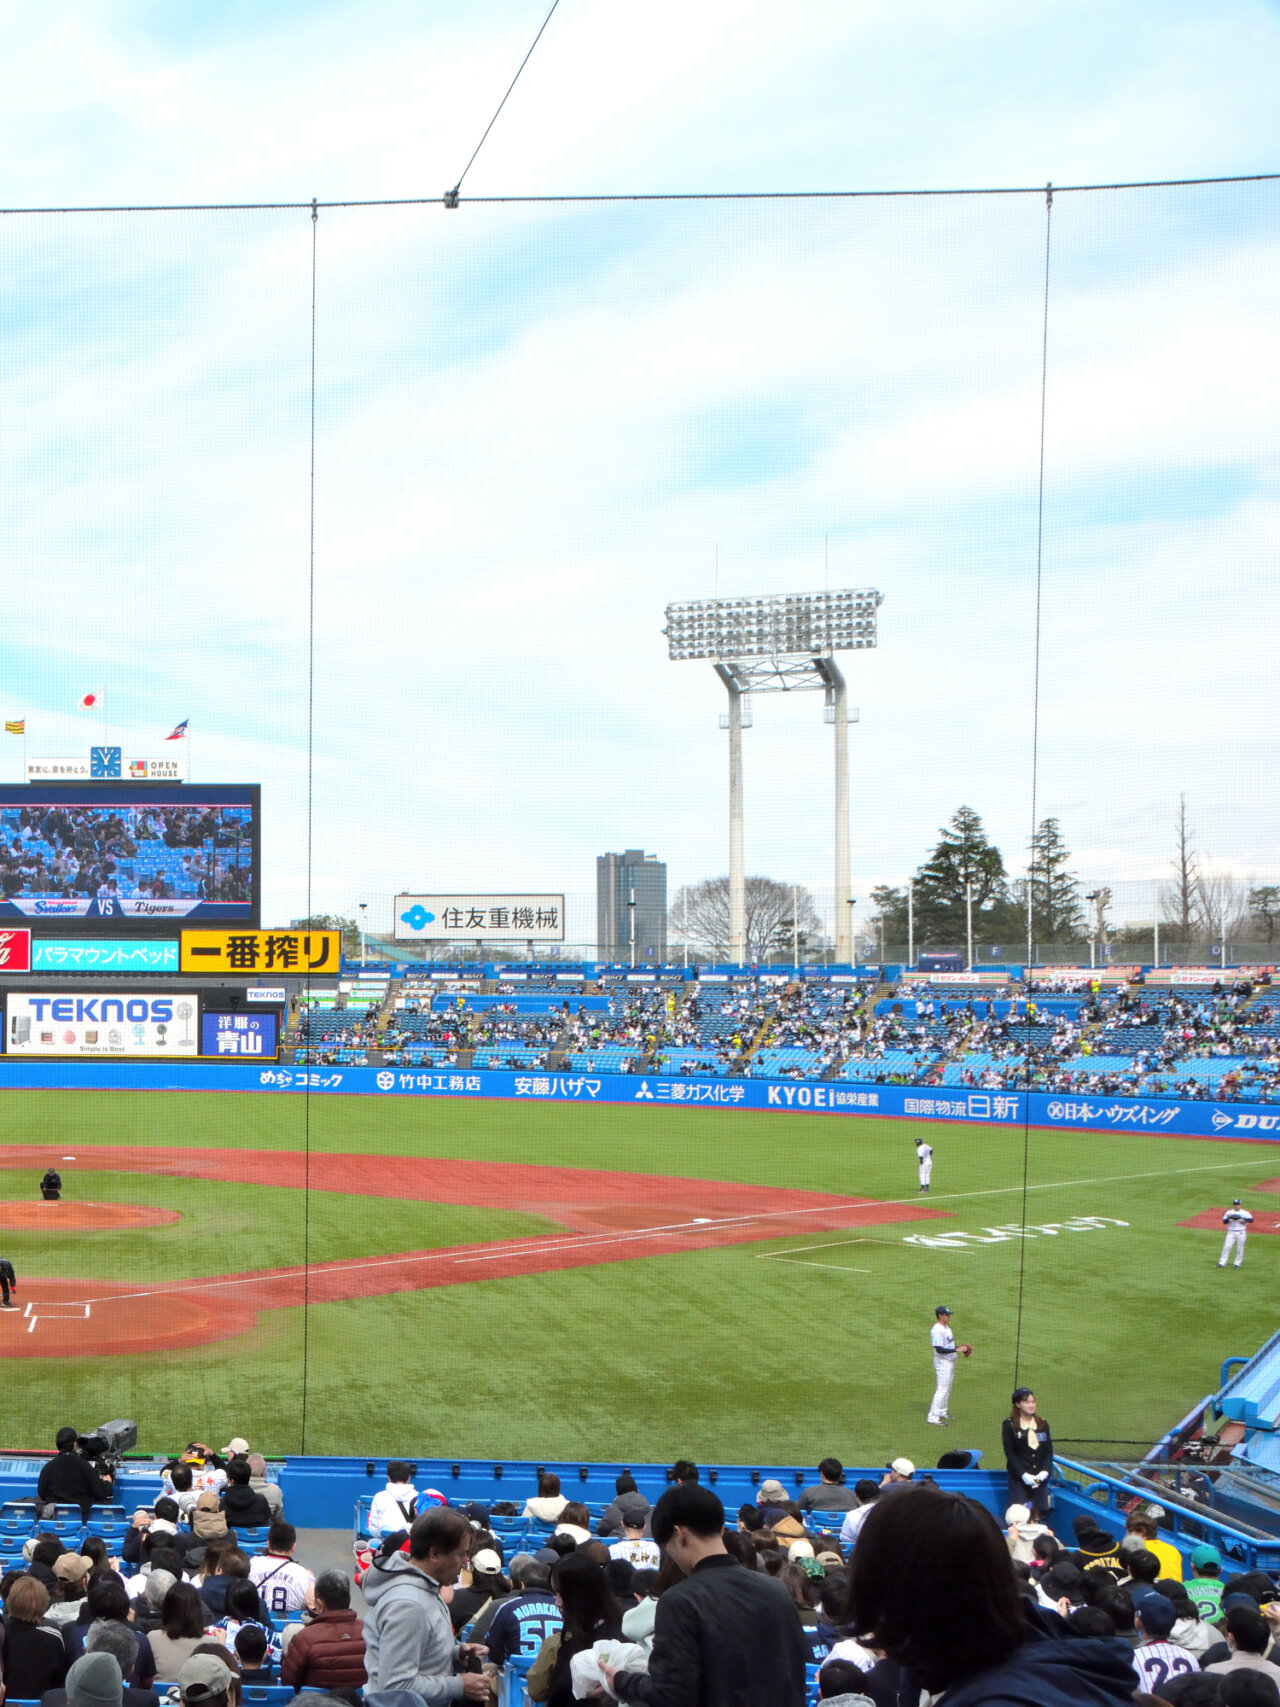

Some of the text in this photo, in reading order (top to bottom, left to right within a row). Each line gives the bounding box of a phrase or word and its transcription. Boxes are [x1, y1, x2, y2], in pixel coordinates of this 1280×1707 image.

[34, 901, 76, 914] Swallows
[98, 899, 113, 915] VS
[135, 902, 174, 914] Tigers
[442, 906, 559, 930] 住友重機械
[34, 948, 176, 964] パラマウントベッド
[190, 936, 330, 968] 一番搾り
[28, 999, 172, 1022] TEKNOS
[218, 1016, 260, 1030] 洋服の
[216, 1030, 262, 1053] 青山
[260, 1070, 342, 1088] めちゃコミック
[399, 1074, 481, 1091] 竹中工務店
[514, 1077, 601, 1097] 安藤ハザマ
[656, 1082, 744, 1102] 三菱ガス化学
[768, 1086, 879, 1107] KYOEI 協栄産業
[1064, 1102, 1180, 1125] 日本ハウズイング
[1234, 1114, 1280, 1130] DU
